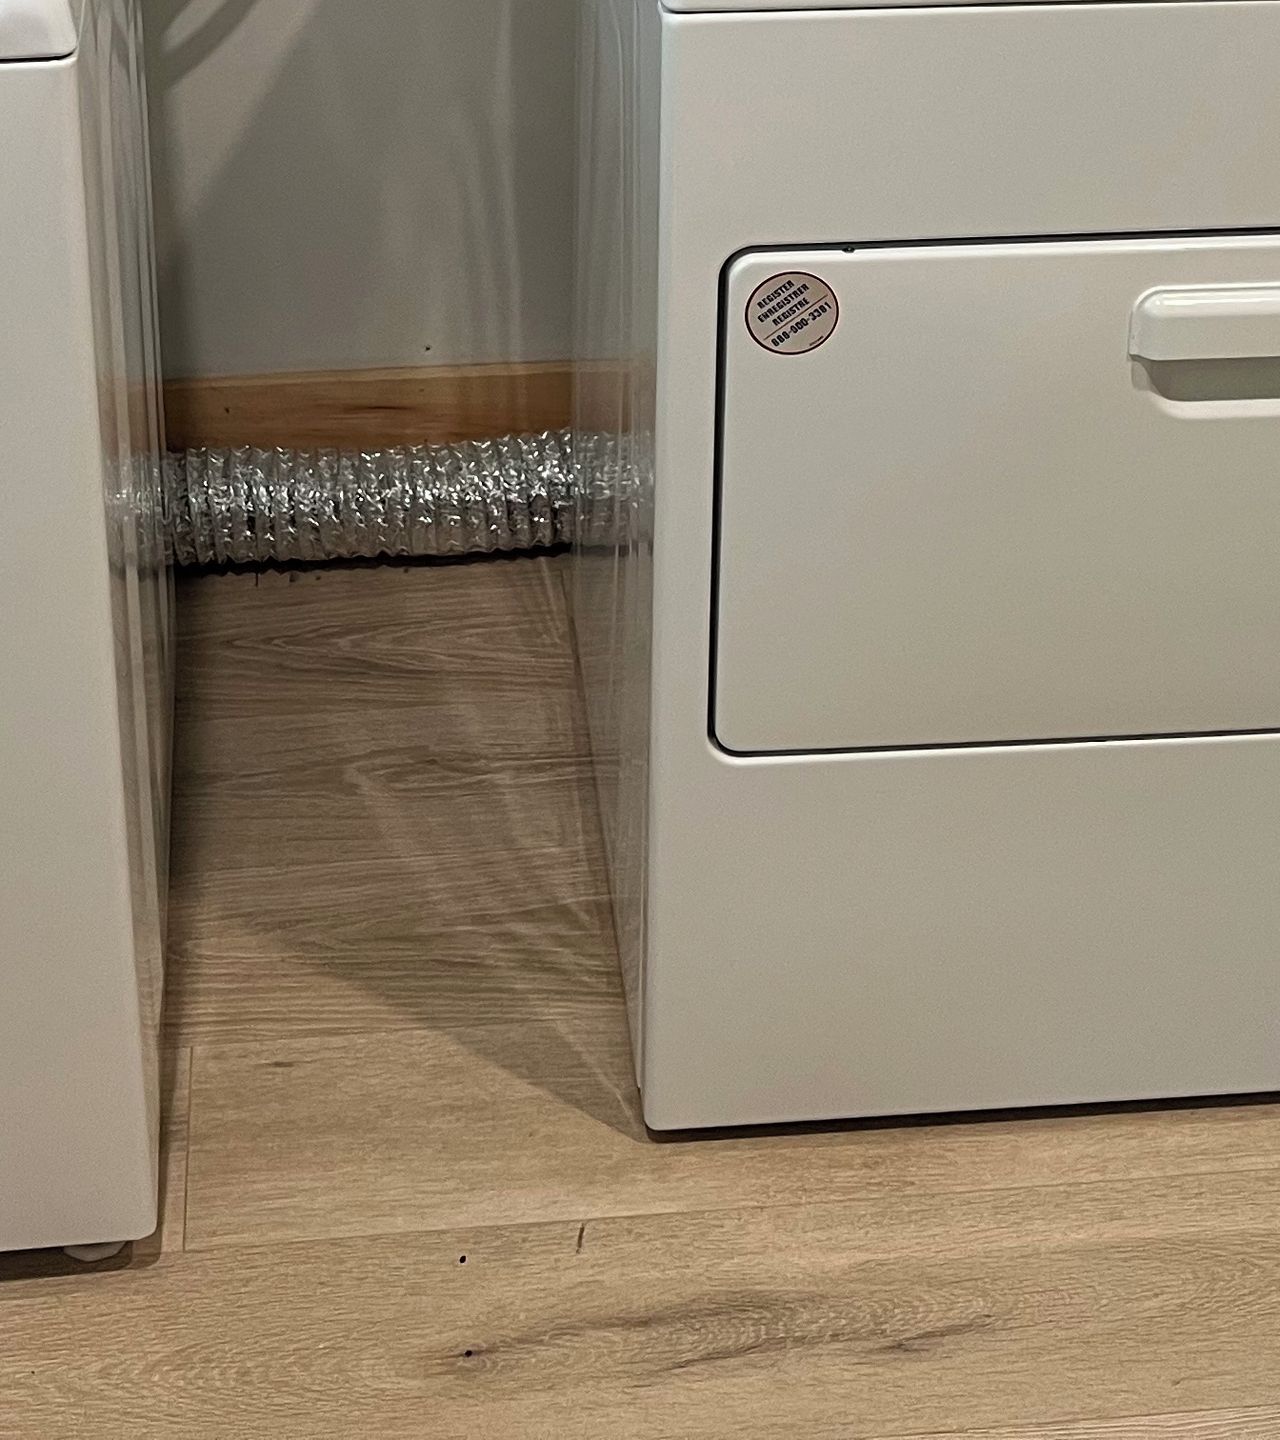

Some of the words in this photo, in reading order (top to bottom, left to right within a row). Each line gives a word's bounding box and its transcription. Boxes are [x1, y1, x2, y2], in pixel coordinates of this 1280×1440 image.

[756, 279, 796, 310] REGISTER
[757, 283, 810, 323] ENREGISTRER
[771, 297, 811, 327] REGISTRE
